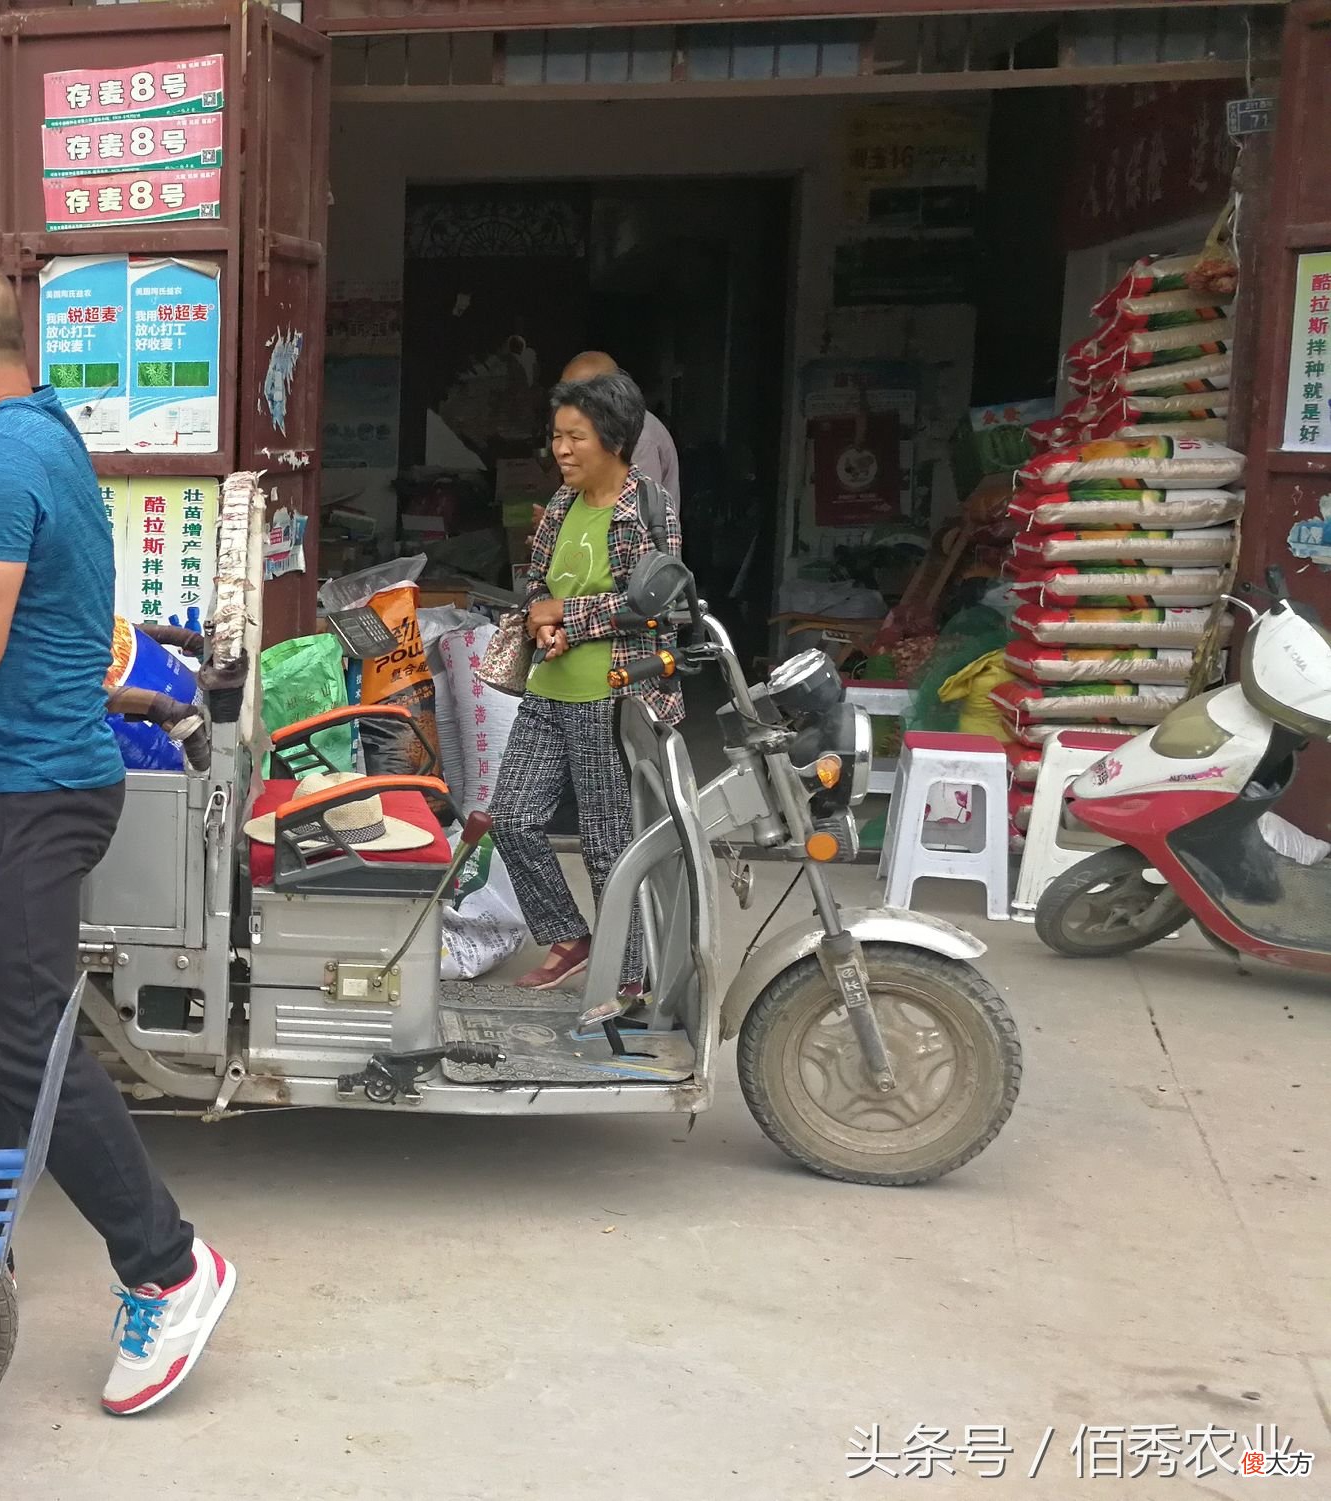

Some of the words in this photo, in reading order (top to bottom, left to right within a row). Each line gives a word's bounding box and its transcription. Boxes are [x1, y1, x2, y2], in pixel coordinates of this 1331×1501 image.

[65, 72, 187, 109] 存麦8号
[65, 126, 187, 161] 存麦8号
[65, 180, 186, 214] 存麦8号
[46, 325, 96, 338] 放心打工
[135, 323, 186, 336] 放心打工
[1299, 273, 1331, 443] 酷拉斯拌种就是好
[140, 496, 166, 625] 酷拉斯拌种就
[180, 488, 204, 604] 壮苗增产病虫少
